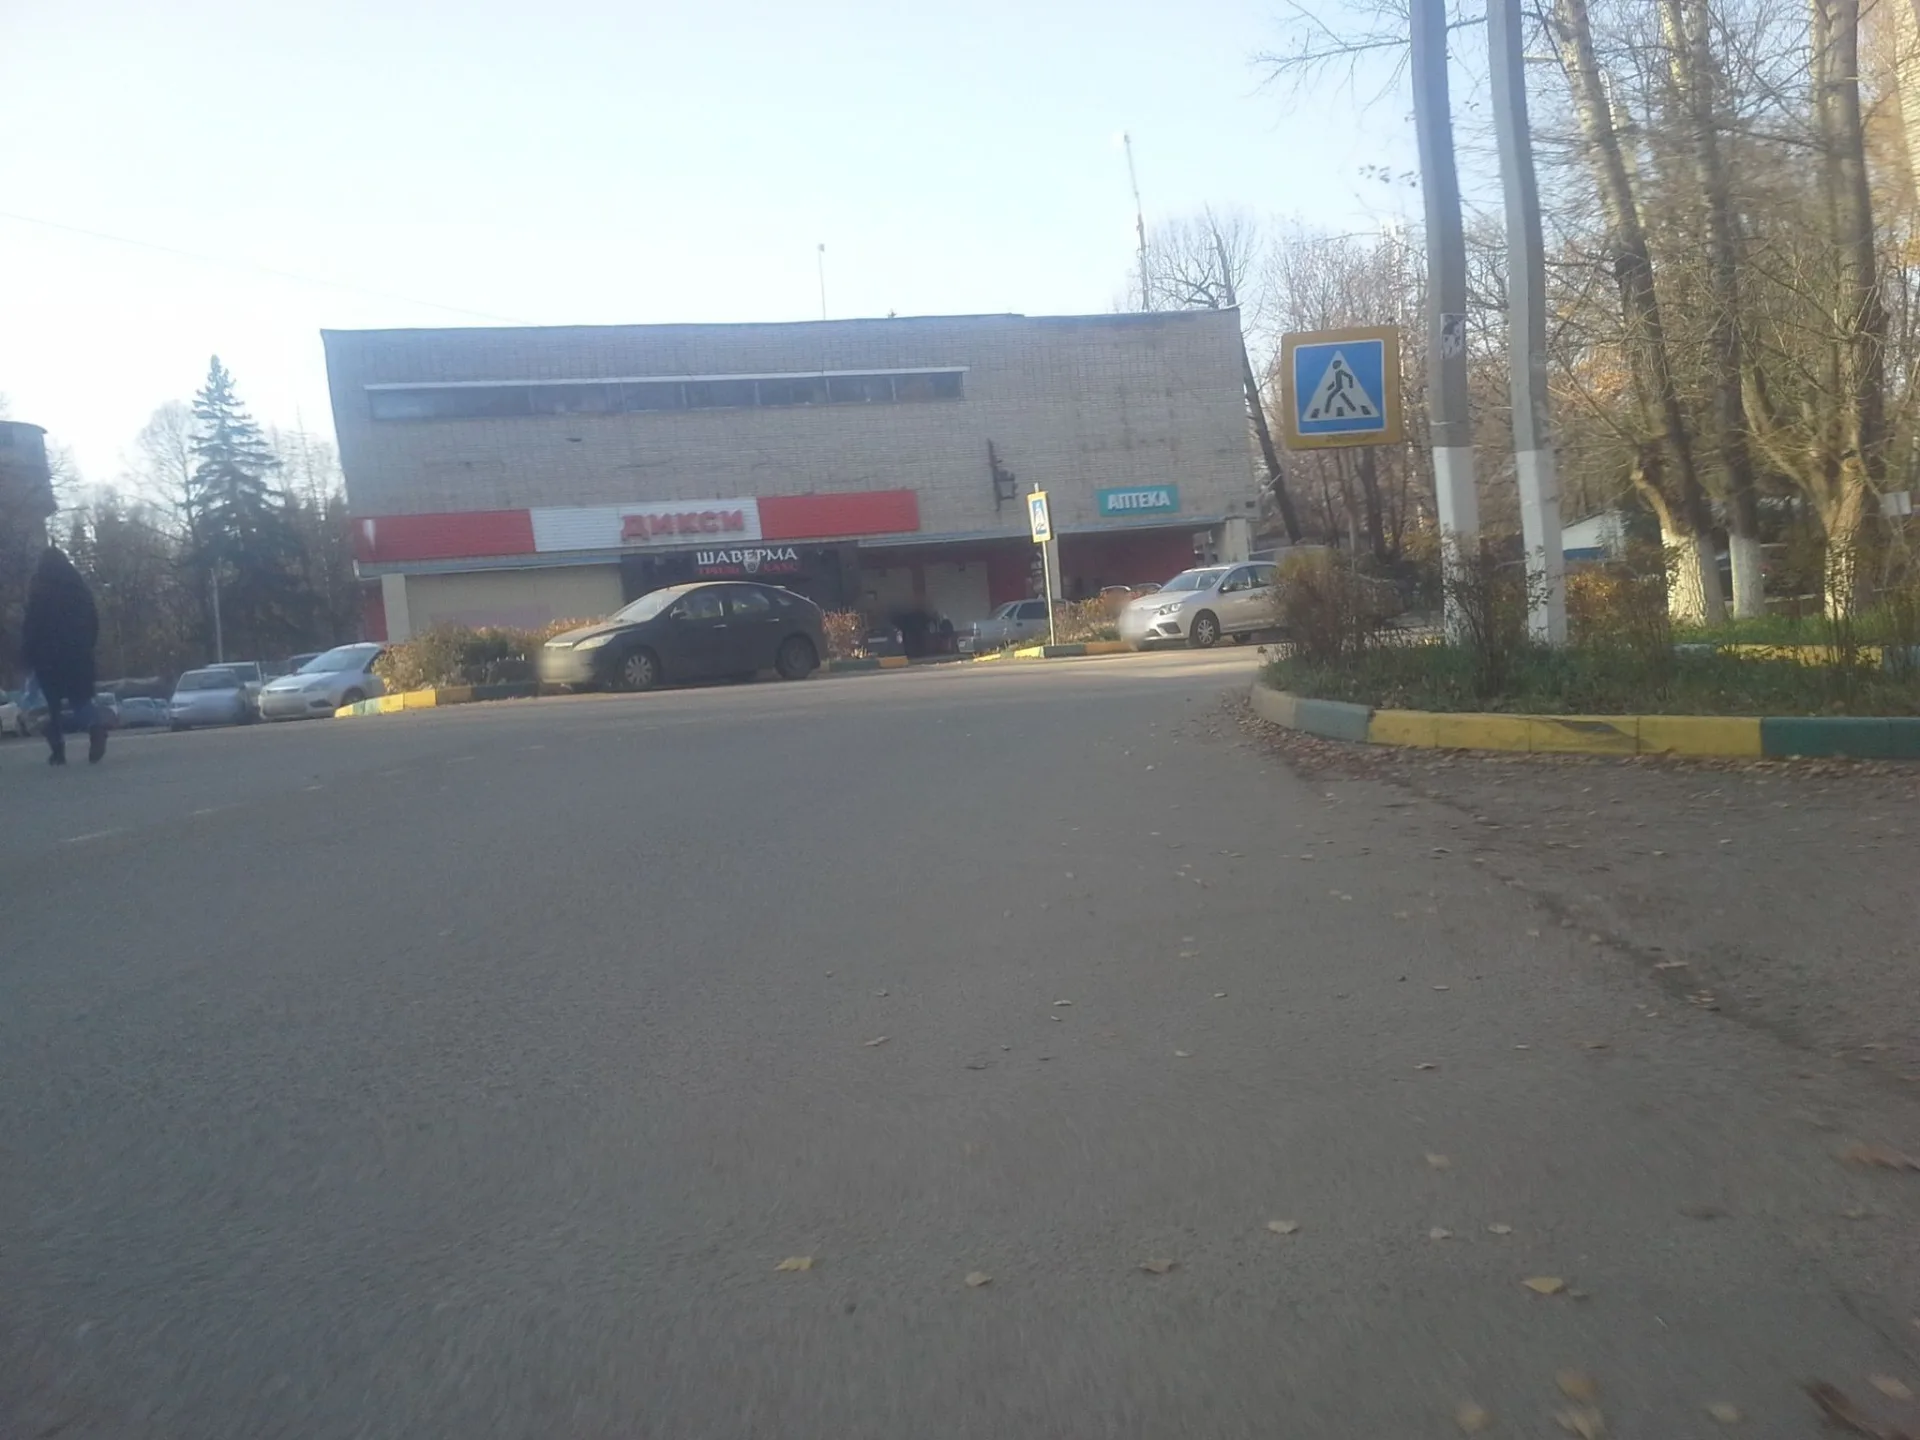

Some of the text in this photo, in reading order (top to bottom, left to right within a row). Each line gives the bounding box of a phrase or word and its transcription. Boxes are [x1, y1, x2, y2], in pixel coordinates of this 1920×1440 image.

[1107, 490, 1171, 511] АПТЕКА
[620, 509, 745, 541] ДИКСИ
[696, 547, 798, 565] ШАВЕРМА
